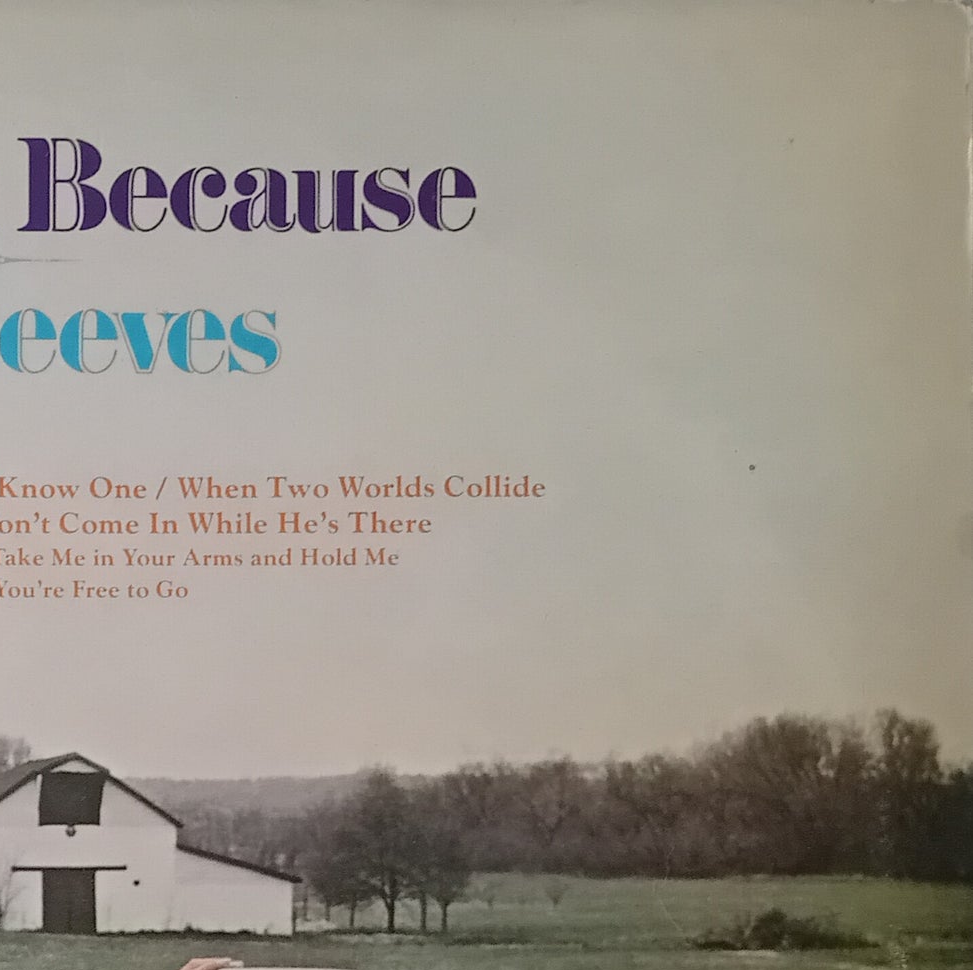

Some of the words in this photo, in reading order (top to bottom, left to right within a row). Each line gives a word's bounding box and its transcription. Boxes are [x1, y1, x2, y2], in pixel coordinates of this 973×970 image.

[16, 136, 478, 234] Because
[89, 477, 147, 499] One
[177, 476, 258, 499] When
[267, 477, 329, 499] Two
[338, 475, 435, 498] Worlds
[444, 475, 545, 498] Collide
[59, 512, 139, 534] Come
[149, 512, 178, 534] In
[188, 512, 267, 534] While
[278, 512, 339, 534] He's
[348, 511, 431, 533] There
[52, 548, 85, 566] Me
[94, 548, 114, 566] in
[123, 548, 175, 566] Your
[183, 548, 243, 566] Arms
[251, 547, 291, 566] and
[301, 547, 356, 566] Hold
[365, 548, 399, 566] Me
[73, 580, 120, 598] Free
[128, 583, 149, 598] to
[156, 580, 188, 598] Go
